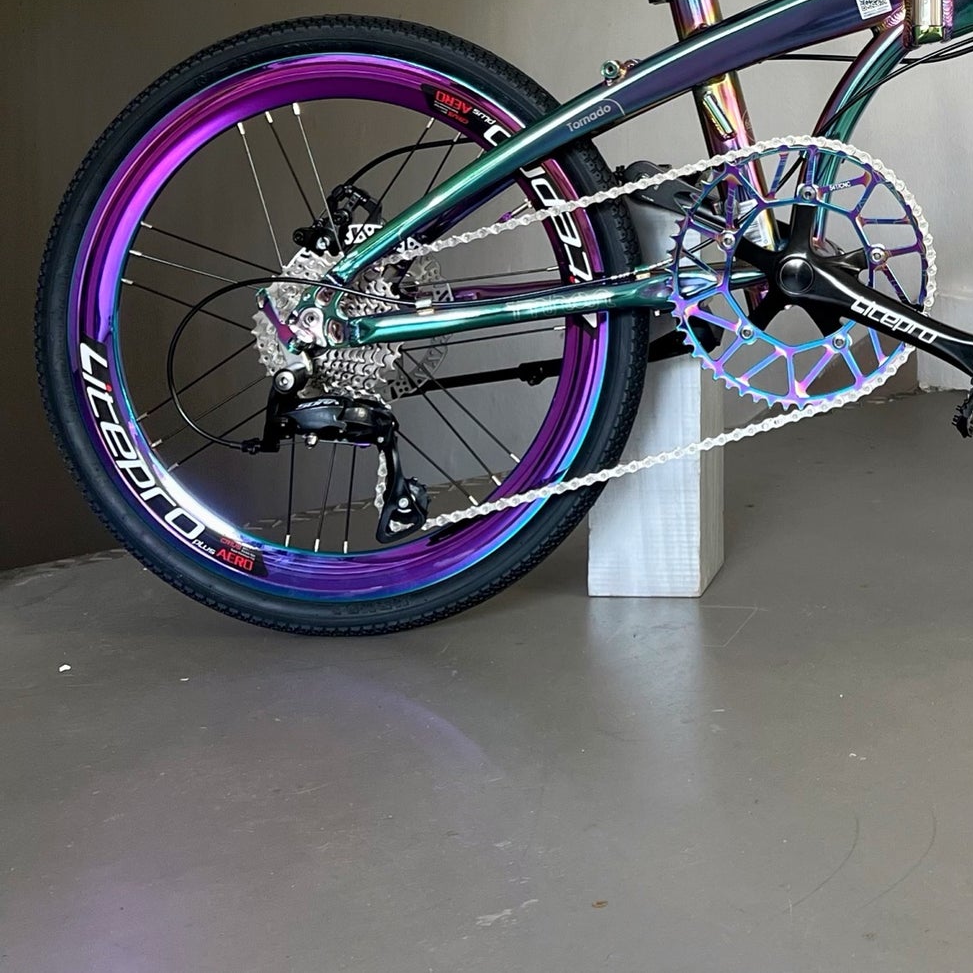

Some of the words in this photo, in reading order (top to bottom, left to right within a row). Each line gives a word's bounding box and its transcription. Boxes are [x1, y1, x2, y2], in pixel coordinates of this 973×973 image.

[435, 90, 472, 115] AERO
[472, 108, 497, 126] plus
[566, 104, 612, 133] Tornado
[79, 342, 208, 540] Litepro
[192, 538, 217, 556] plus
[216, 547, 254, 572] AERO
